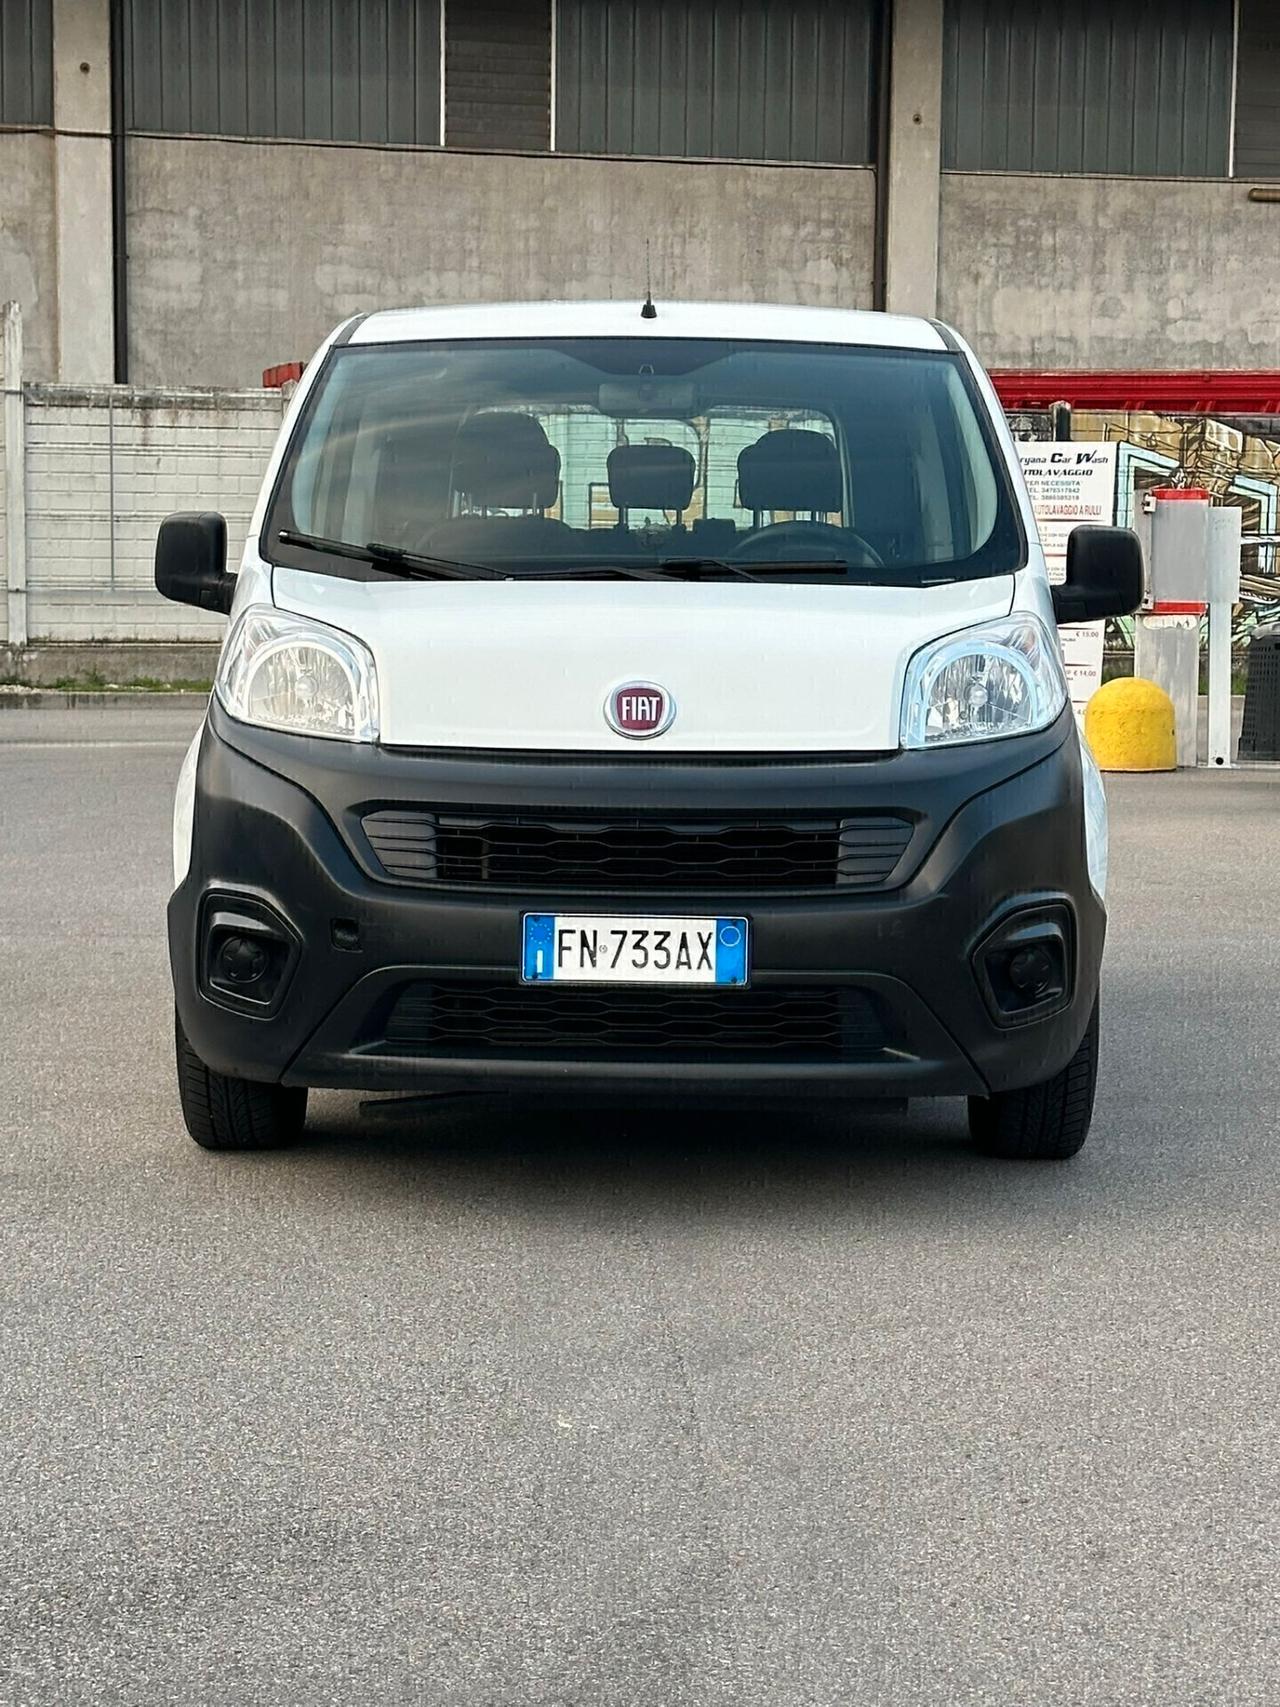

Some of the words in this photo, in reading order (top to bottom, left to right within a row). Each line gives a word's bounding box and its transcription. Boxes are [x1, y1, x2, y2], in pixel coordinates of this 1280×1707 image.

[1019, 457, 1047, 466] ryana
[1050, 453, 1073, 464] Car
[1076, 449, 1109, 465] Wash
[621, 696, 661, 721] FIAT
[558, 928, 598, 969] FN
[610, 930, 714, 971] 733AX
